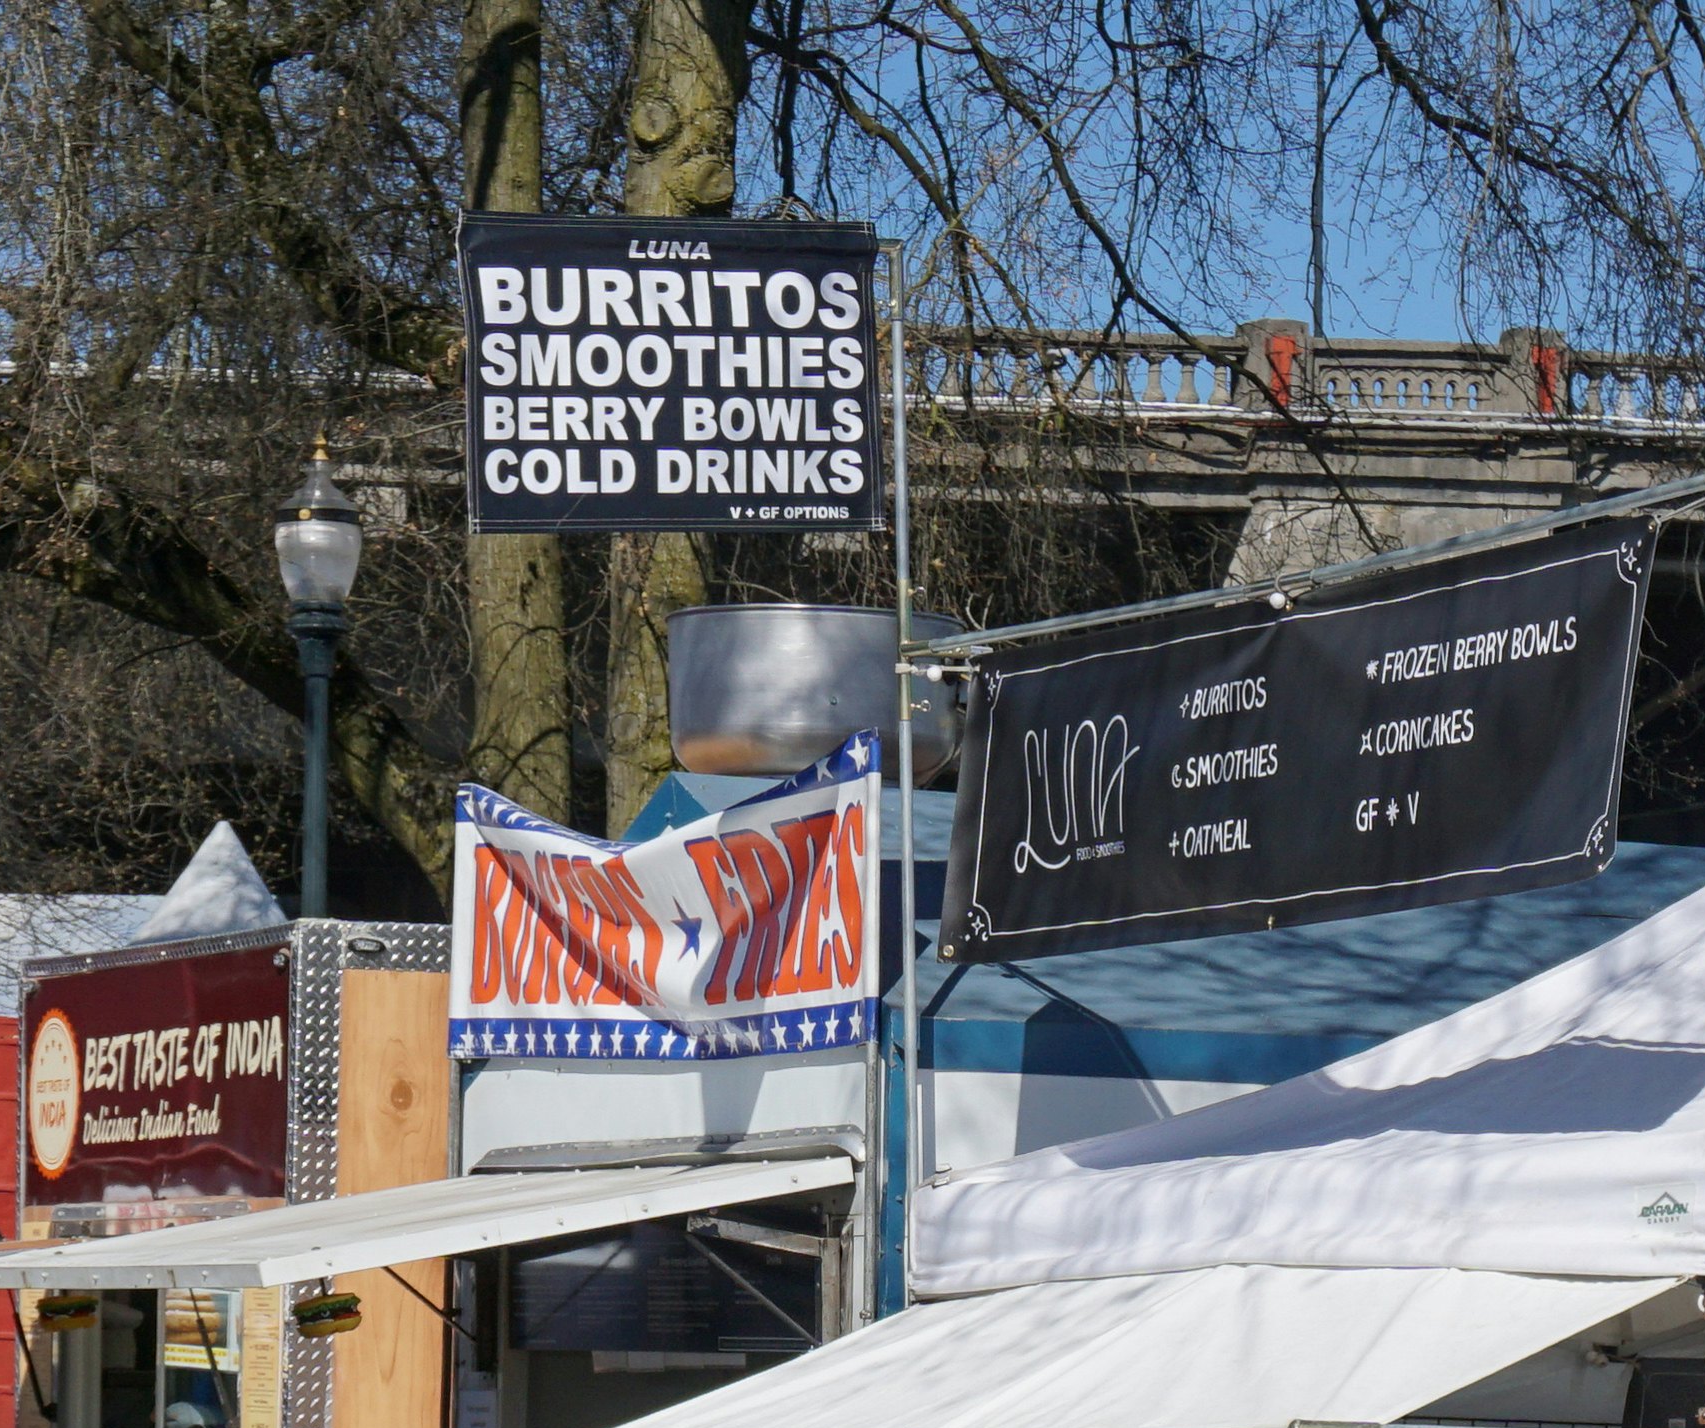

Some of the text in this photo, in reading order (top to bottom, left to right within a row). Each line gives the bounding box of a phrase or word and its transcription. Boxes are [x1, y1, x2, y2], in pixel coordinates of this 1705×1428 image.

[628, 240, 711, 260] LUNA
[478, 267, 861, 330] BURRITOS
[480, 333, 864, 389] SMOOTHIES
[483, 396, 864, 443] BERRY BOWLS
[483, 449, 864, 495] COLD DRINKS
[729, 507, 743, 520] V
[759, 507, 781, 520] GF
[783, 506, 849, 520] OPTIONS
[1382, 616, 1577, 684] FROZEN BERRY BOWLS
[1191, 676, 1266, 719] BURRITOS
[1375, 709, 1474, 757] CORNCAKES
[1186, 744, 1278, 788] SMOOTHIES
[1356, 792, 1419, 832] GF V
[1183, 819, 1251, 858] OATMEAL
[684, 800, 864, 1006] FRIES
[83, 1015, 282, 1092] BEST TASTE OF INDIA
[39, 1100, 66, 1129] INDIA
[83, 1093, 221, 1145] Delicious Indian Food
